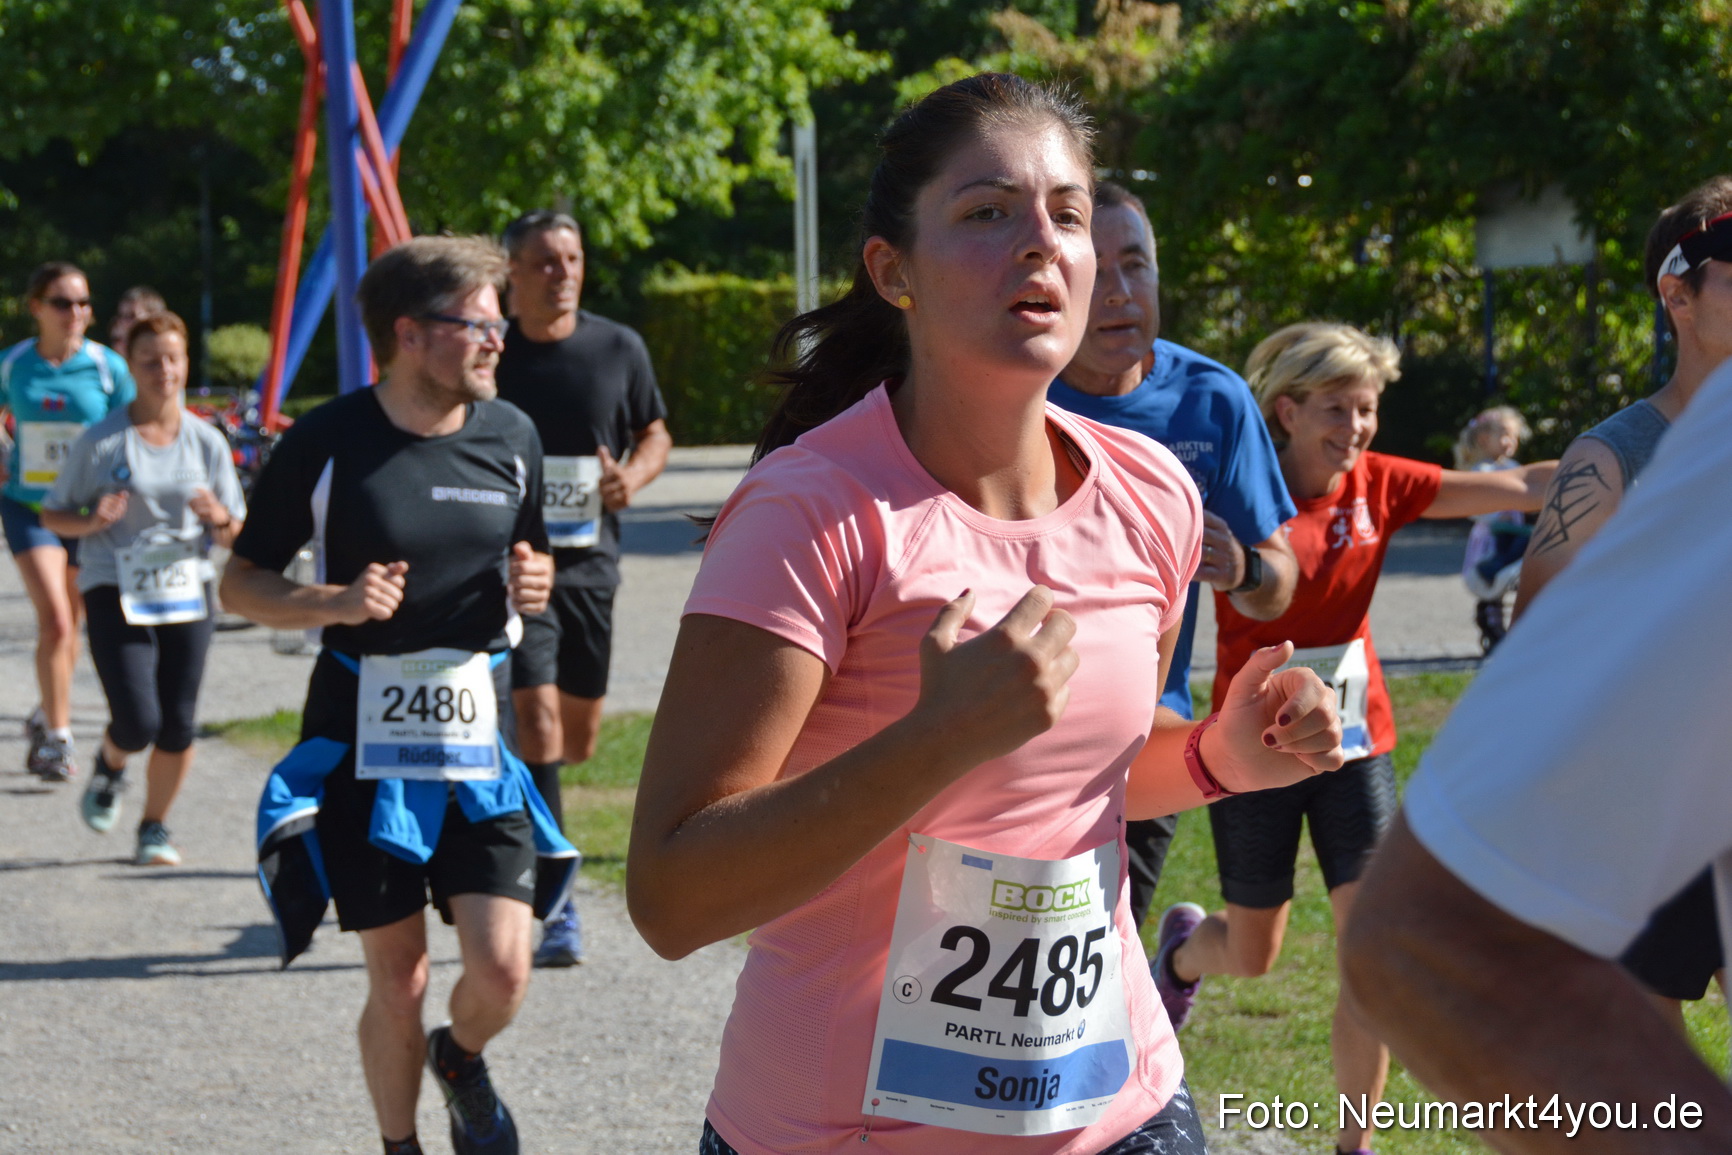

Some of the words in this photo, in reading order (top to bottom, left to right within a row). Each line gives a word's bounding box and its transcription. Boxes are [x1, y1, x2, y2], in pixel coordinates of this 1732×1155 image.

[382, 685, 476, 724] 2480
[991, 878, 1091, 912] BOCK
[989, 907, 1029, 923] inspired
[1031, 914, 1043, 925] by
[1044, 914, 1066, 923] smart
[931, 925, 1106, 1017] 2485
[945, 1022, 1006, 1046] PARTL
[1011, 1027, 1075, 1048] Neumarkt
[974, 1066, 1060, 1108] Sonja
